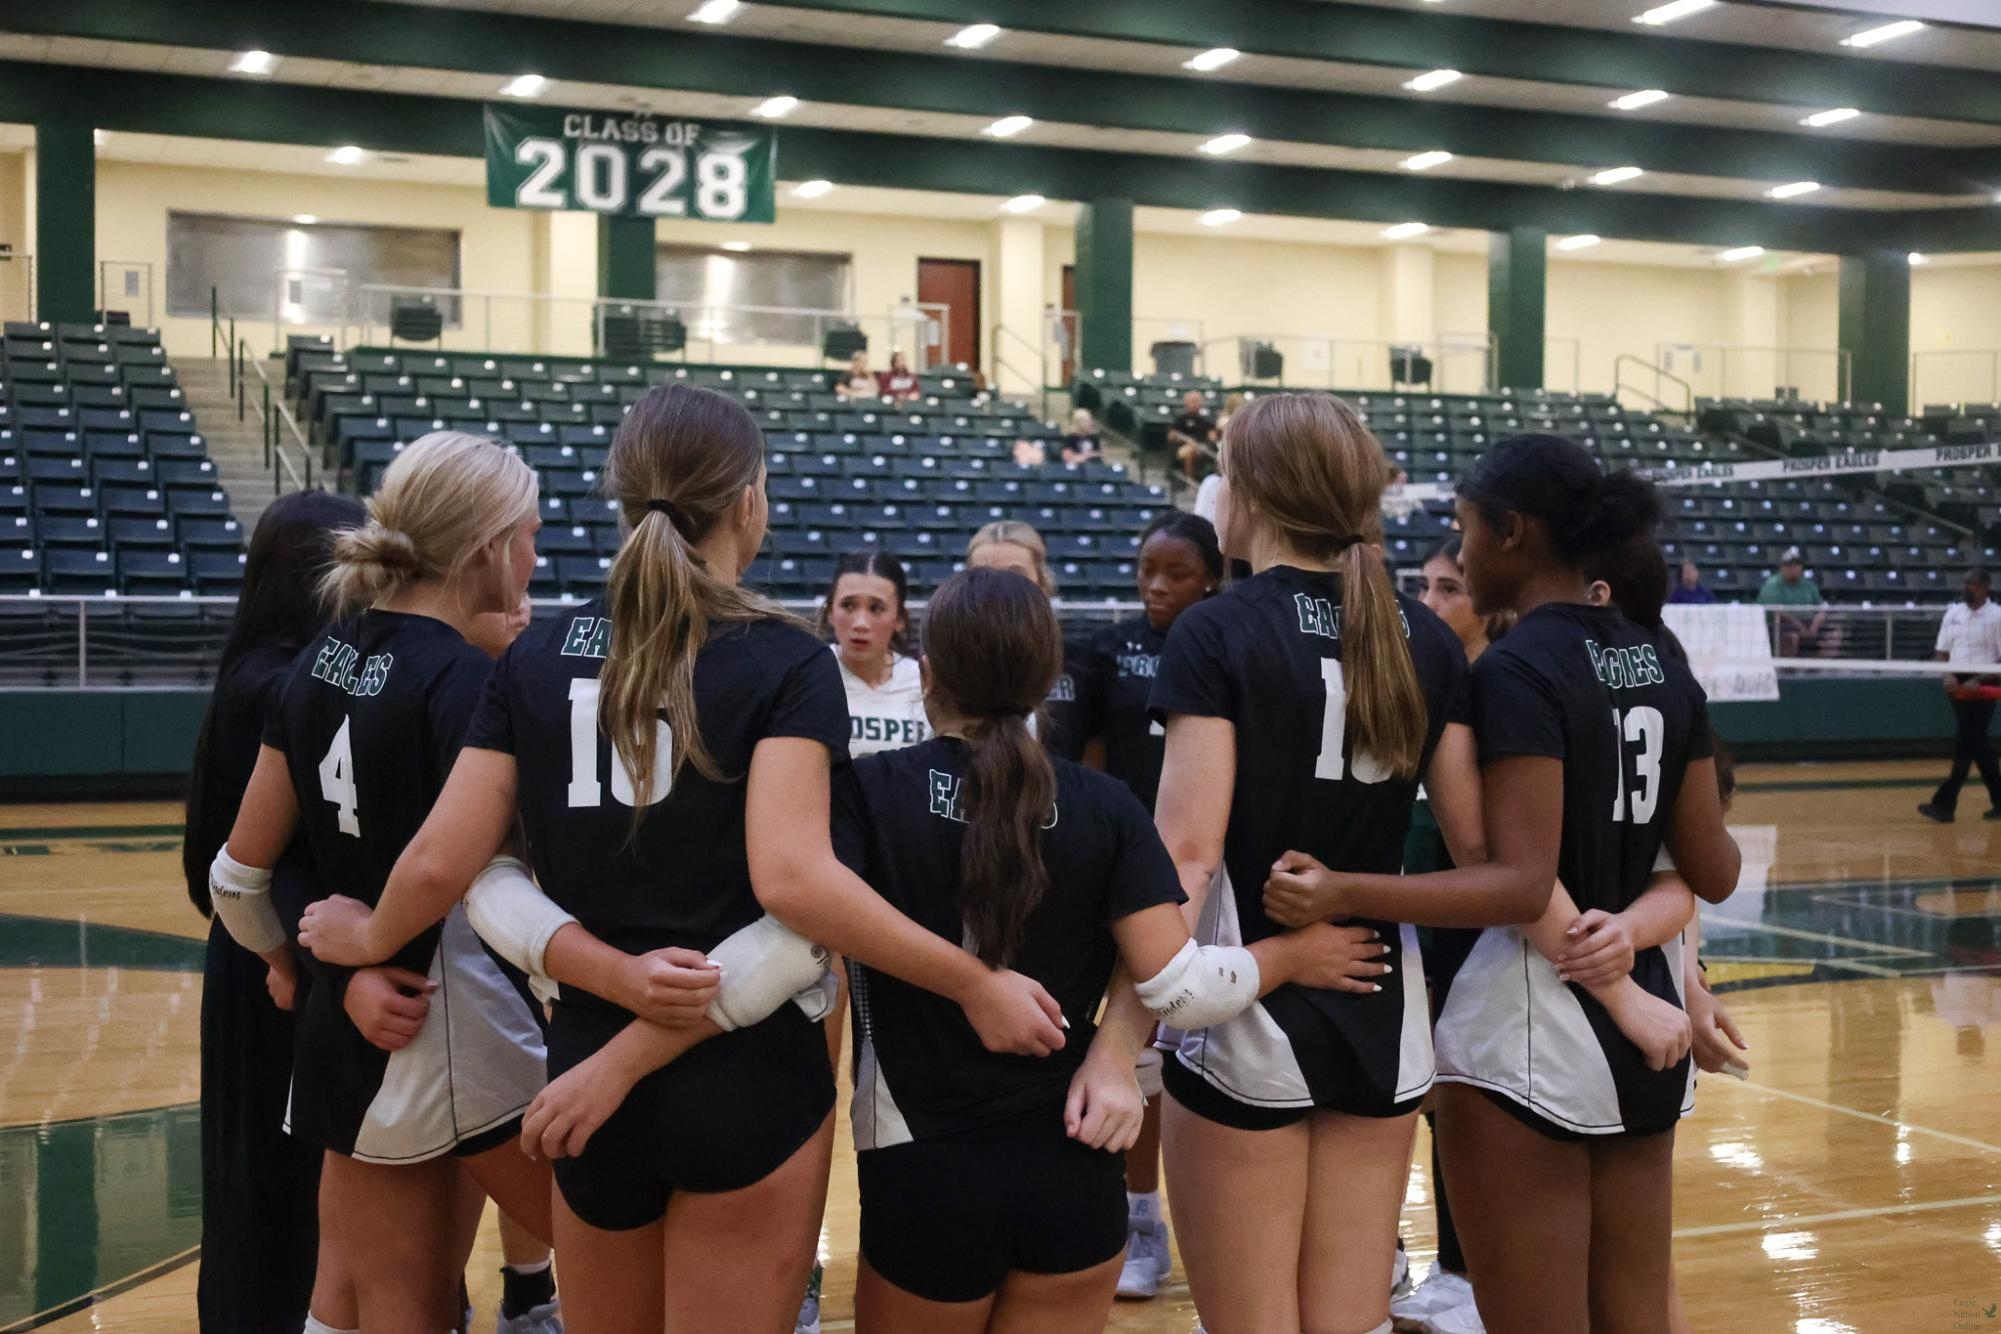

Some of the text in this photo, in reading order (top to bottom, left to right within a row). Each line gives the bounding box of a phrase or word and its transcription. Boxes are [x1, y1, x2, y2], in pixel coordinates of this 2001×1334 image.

[563, 114, 702, 147] CLASS OF
[514, 136, 748, 221] 2028
[1936, 444, 1992, 461] PROSPER
[318, 713, 361, 838] 4
